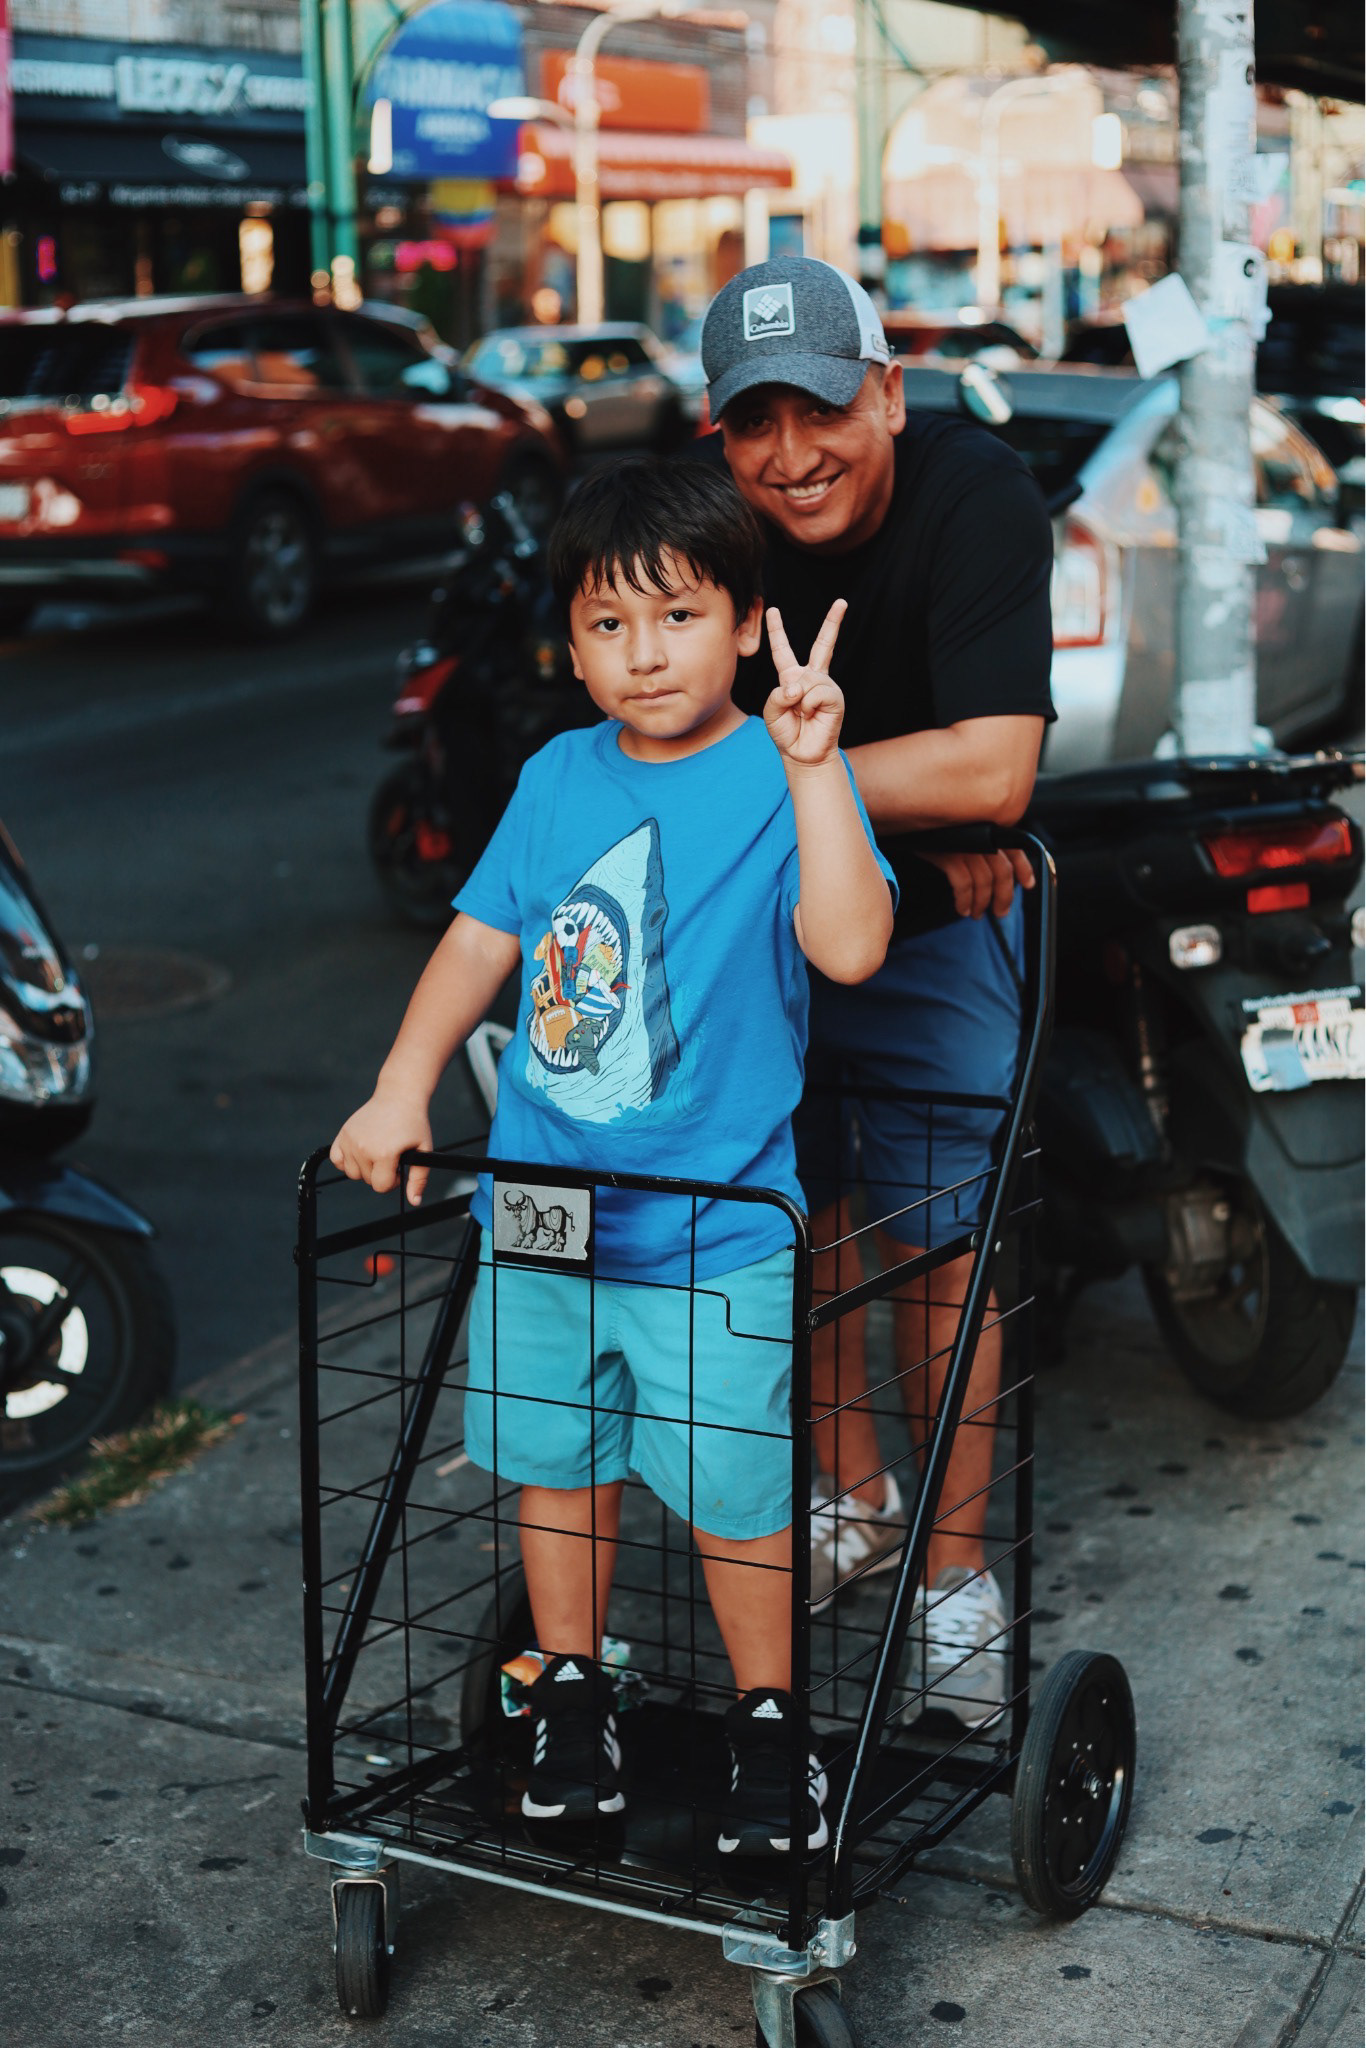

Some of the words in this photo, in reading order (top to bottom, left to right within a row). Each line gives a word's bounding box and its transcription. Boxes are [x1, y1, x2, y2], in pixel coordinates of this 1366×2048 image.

[750, 320, 789, 333] Columbia
[554, 1673, 585, 1682] adidas
[751, 1711, 783, 1720] adidas
